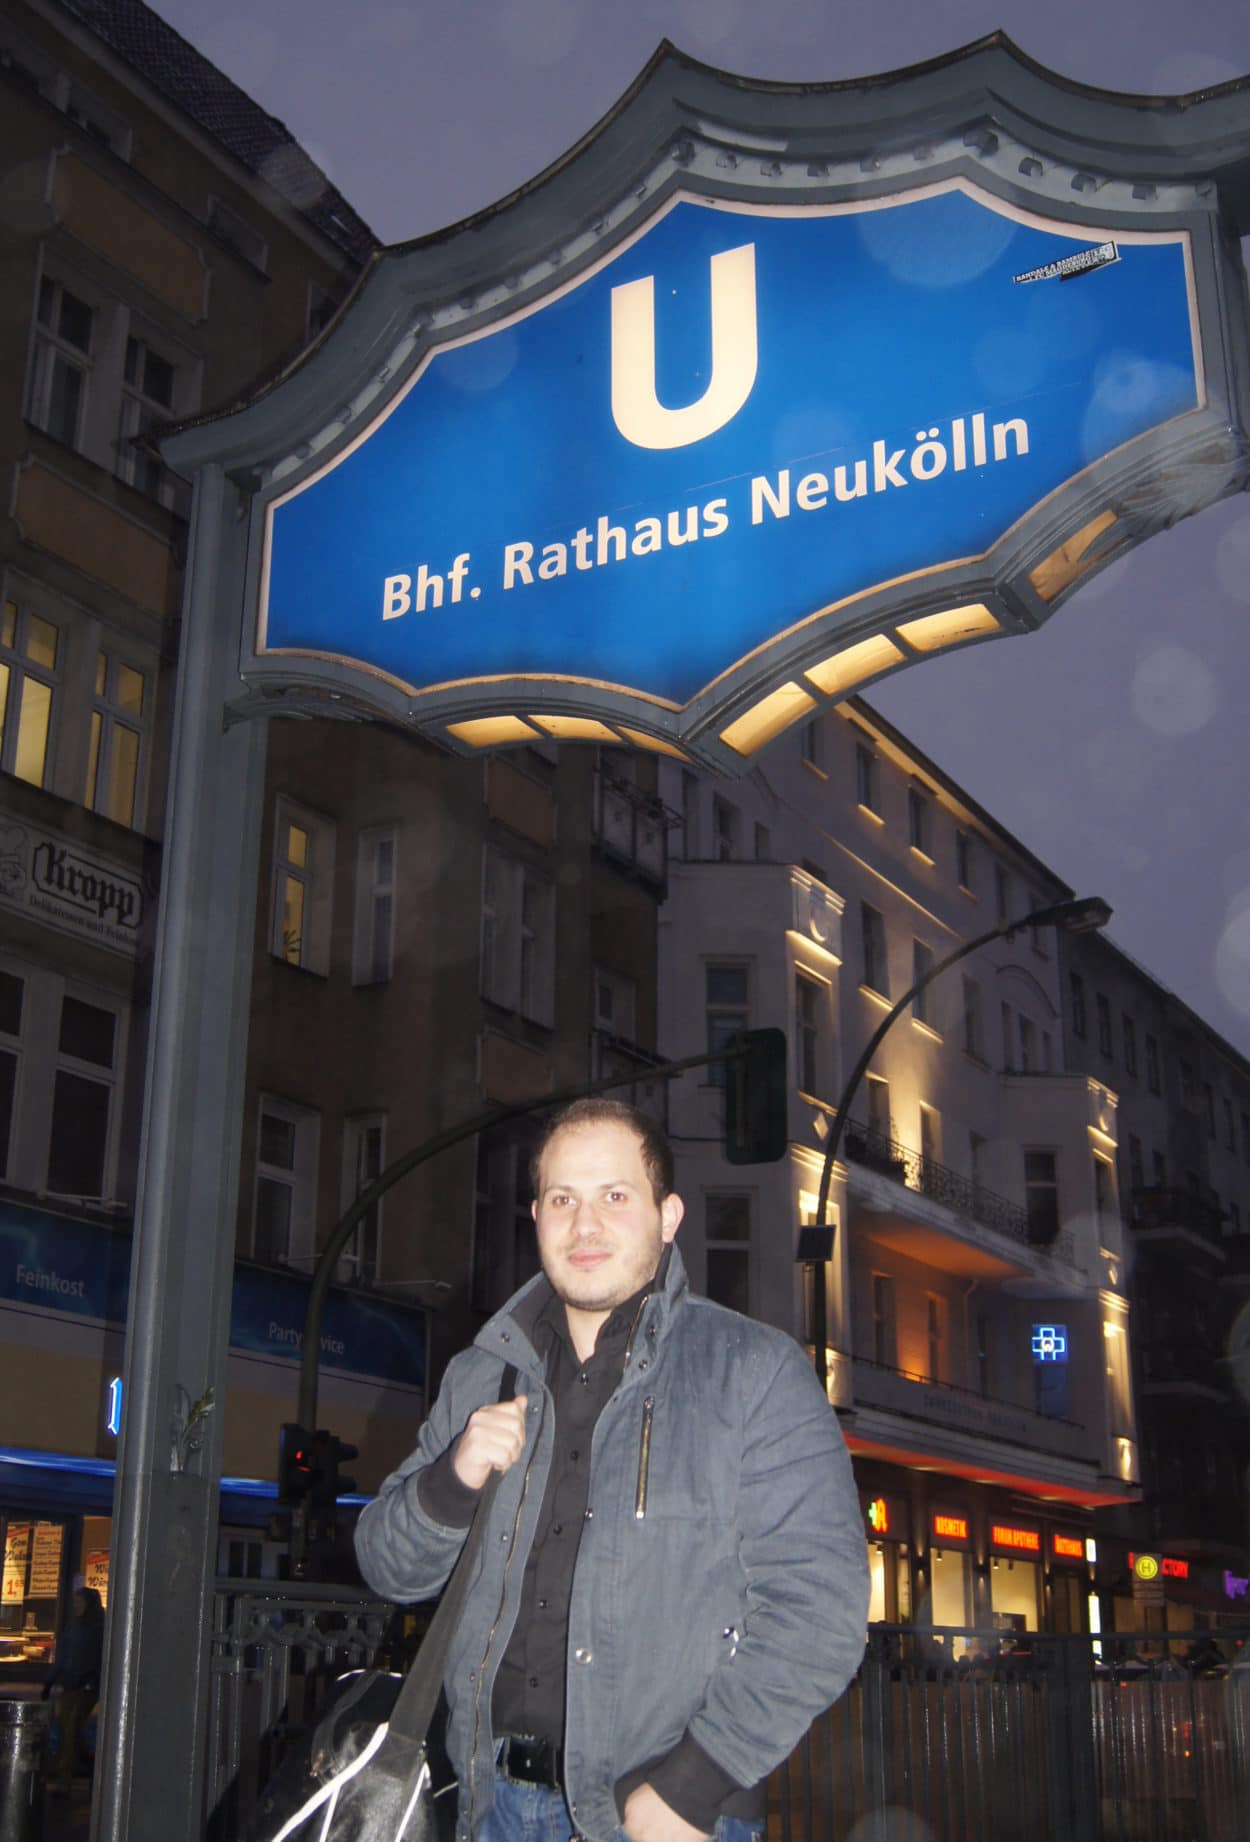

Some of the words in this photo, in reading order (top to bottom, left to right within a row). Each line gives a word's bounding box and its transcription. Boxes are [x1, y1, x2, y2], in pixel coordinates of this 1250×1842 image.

[609, 242, 759, 450] U
[382, 552, 482, 621] Bhf.
[502, 497, 729, 590] Rathaus
[750, 412, 1030, 525] Neukölln
[43, 842, 135, 926] Kropp
[16, 1263, 85, 1297] Feinkost
[268, 1321, 345, 1355] Partyvice
